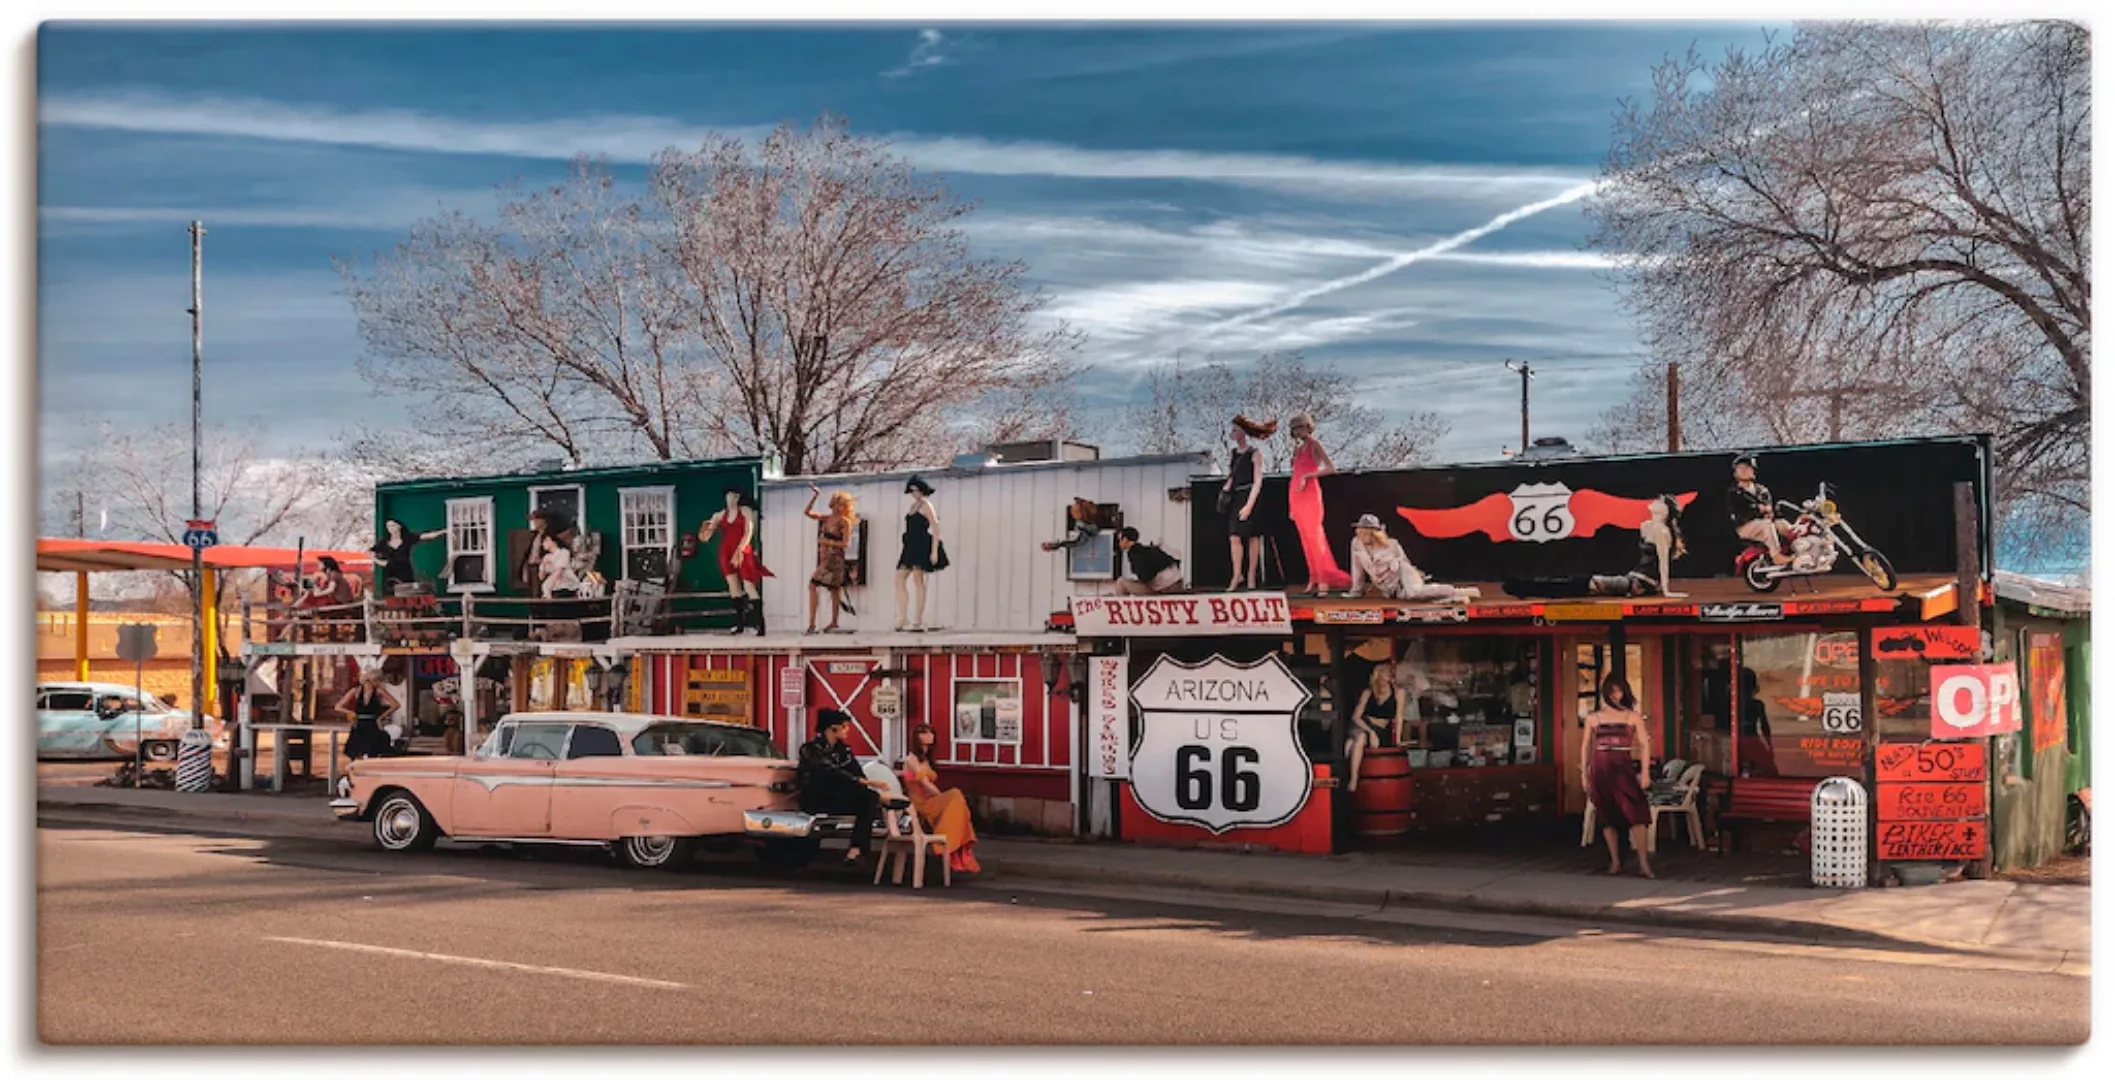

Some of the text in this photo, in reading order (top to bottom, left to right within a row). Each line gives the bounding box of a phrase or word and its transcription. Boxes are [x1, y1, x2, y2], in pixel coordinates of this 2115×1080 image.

[1514, 504, 1566, 536] 66
[187, 531, 213, 547] 66
[1104, 600, 1199, 625] RUSTY
[1208, 598, 1285, 625] BOLT
[1165, 679, 1270, 702] ARIZONA
[1826, 708, 1860, 729] 66
[1174, 744, 1261, 812] 66
[1942, 786, 1967, 804] 66
[1882, 823, 1956, 845] BIKER
